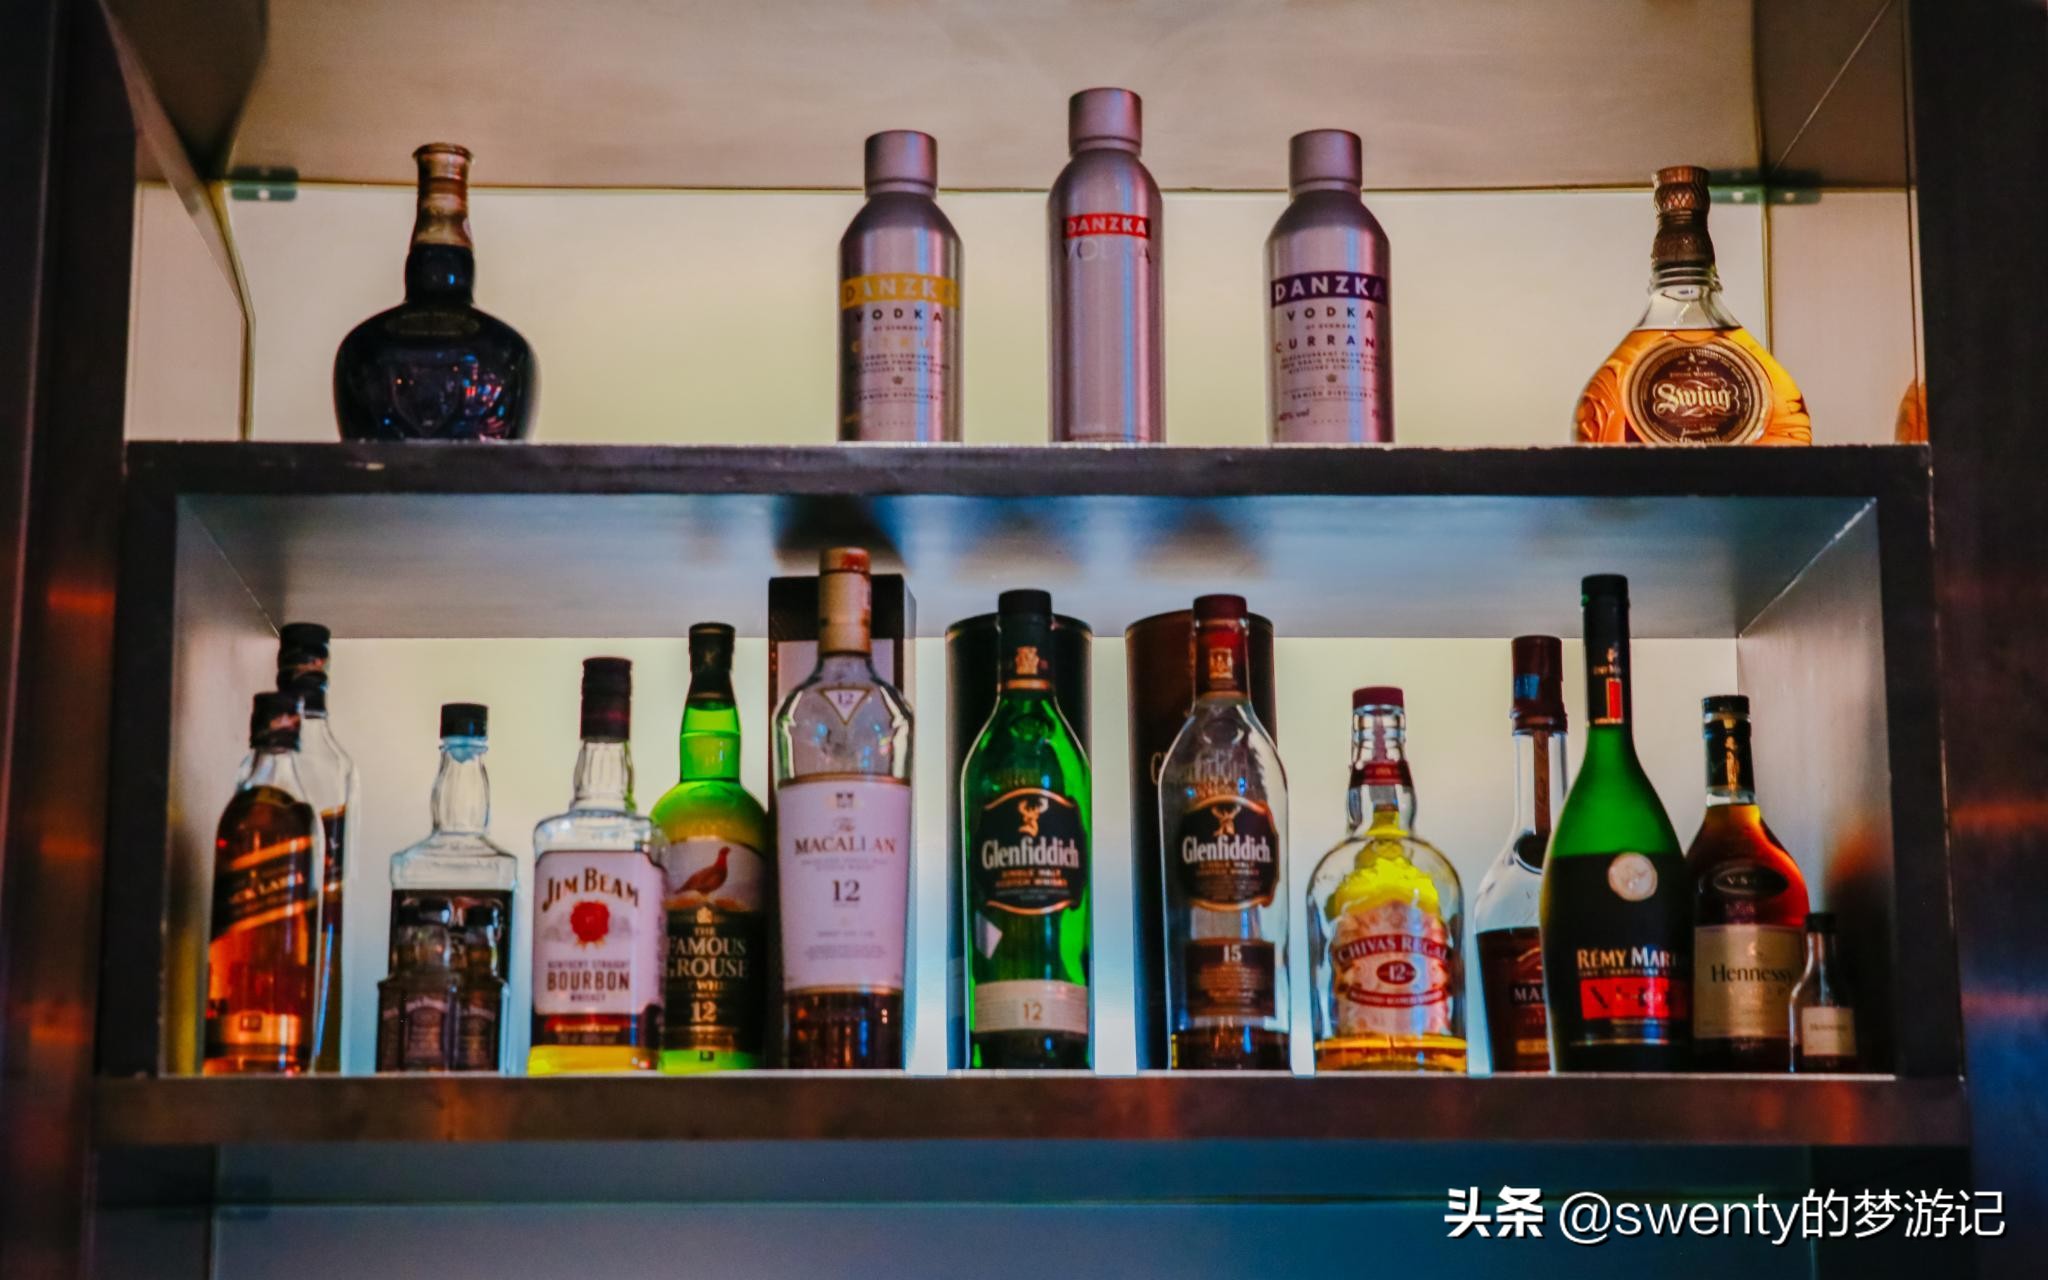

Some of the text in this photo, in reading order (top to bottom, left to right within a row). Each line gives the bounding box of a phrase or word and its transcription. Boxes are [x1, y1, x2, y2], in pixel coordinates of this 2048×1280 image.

[1067, 216, 1147, 236] DANZKA
[1275, 274, 1384, 303] DANZKA
[856, 307, 943, 323] VODKA
[1286, 306, 1375, 322] VODKA
[1656, 382, 1732, 415] Swing
[794, 836, 898, 856] MACALLAN
[982, 836, 1080, 870] Glenfiddich
[1182, 835, 1271, 865] Glenfiddich
[541, 866, 640, 913] JIM BEAM
[832, 878, 861, 903] 12
[1223, 944, 1242, 962] 15
[1338, 938, 1396, 963] CHIVAS
[547, 970, 630, 991] BOURBON
[1388, 964, 1407, 981] 12
[691, 1001, 717, 1022] 12
[1023, 1002, 1042, 1021] 12
